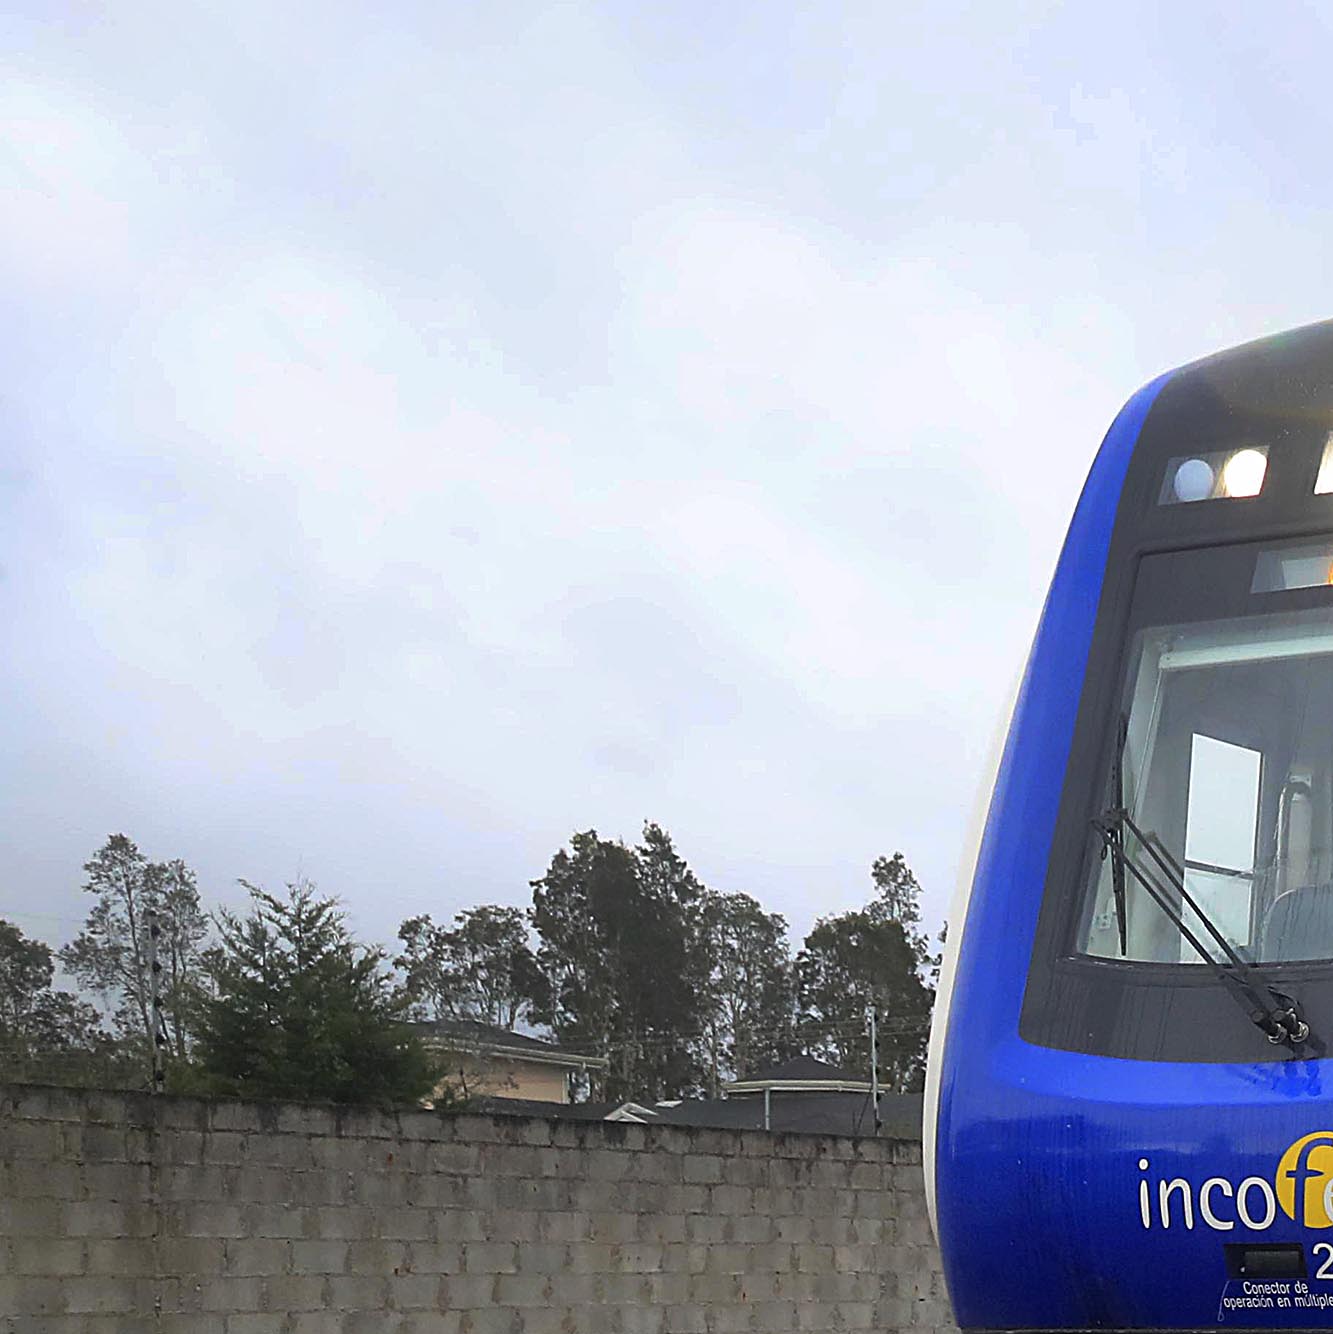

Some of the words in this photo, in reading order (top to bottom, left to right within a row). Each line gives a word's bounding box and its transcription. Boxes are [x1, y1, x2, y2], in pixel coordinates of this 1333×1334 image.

[1243, 1281, 1290, 1295] Conector
[1294, 1281, 1309, 1294] de
[1223, 1295, 1274, 1310] operación
[1277, 1297, 1291, 1307] en
